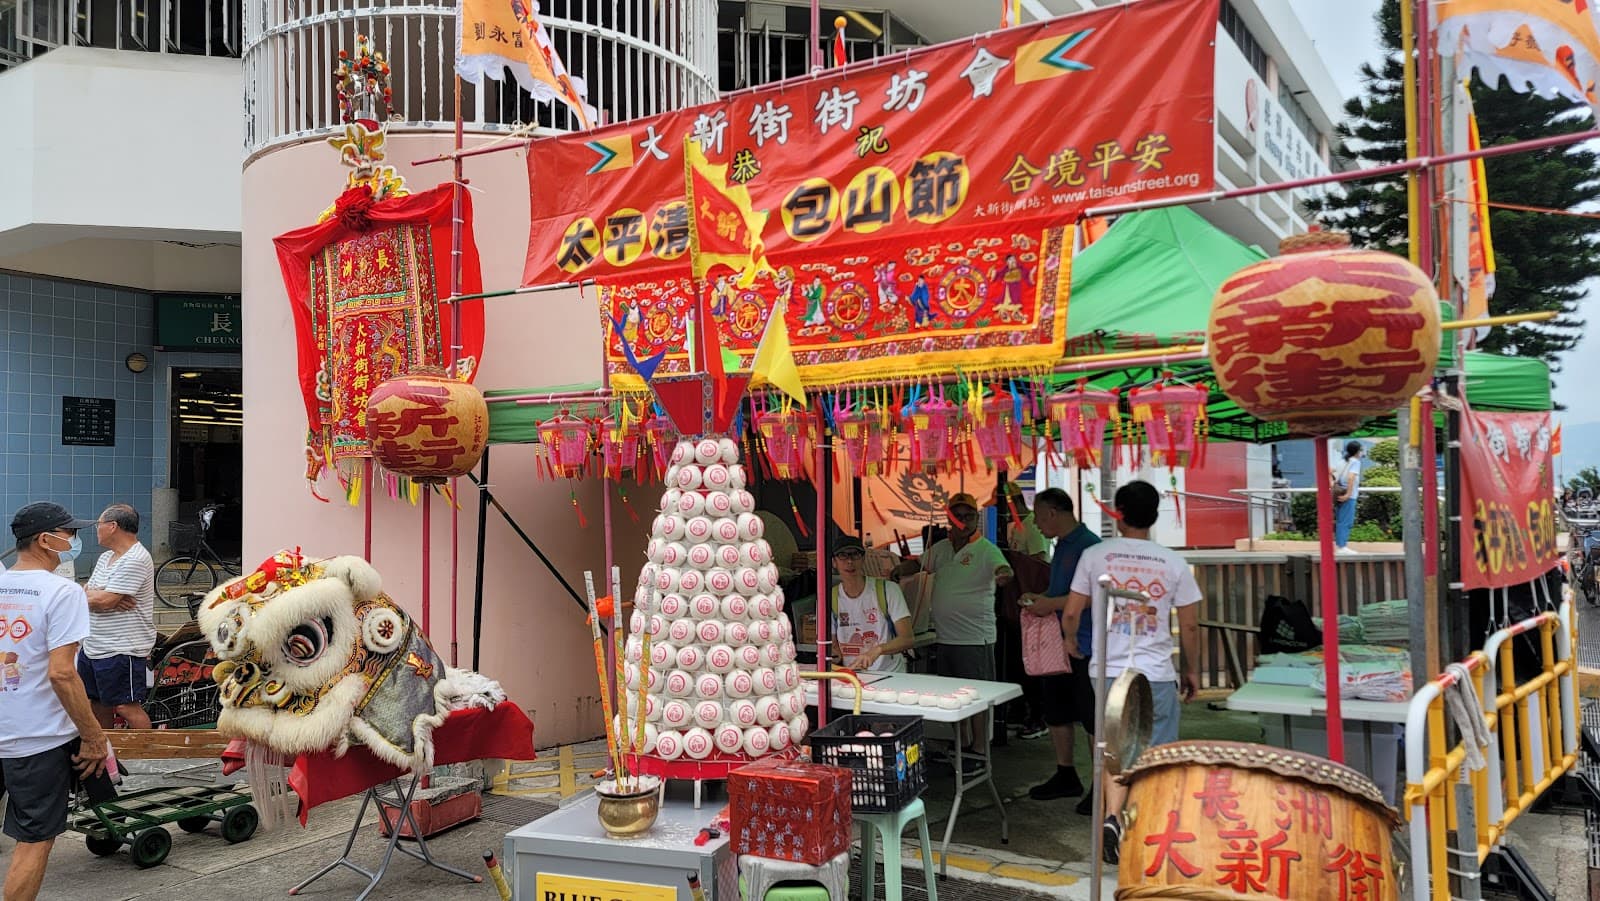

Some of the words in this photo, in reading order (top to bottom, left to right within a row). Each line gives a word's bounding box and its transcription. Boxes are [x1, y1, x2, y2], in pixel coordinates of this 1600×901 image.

[637, 47, 1010, 167] 大新街街坊會
[730, 149, 760, 184] 恭
[856, 126, 888, 157] 祝
[1002, 134, 1172, 193] 合境平安
[1052, 173, 1199, 204] www.taisunstreet.org
[557, 205, 691, 272] 太平清
[784, 156, 965, 238] 包山節
[211, 312, 233, 333] 長
[352, 322, 370, 427] 大新街街坊會
[1194, 769, 1332, 839] 長洲
[1144, 808, 1385, 901] 大新街
